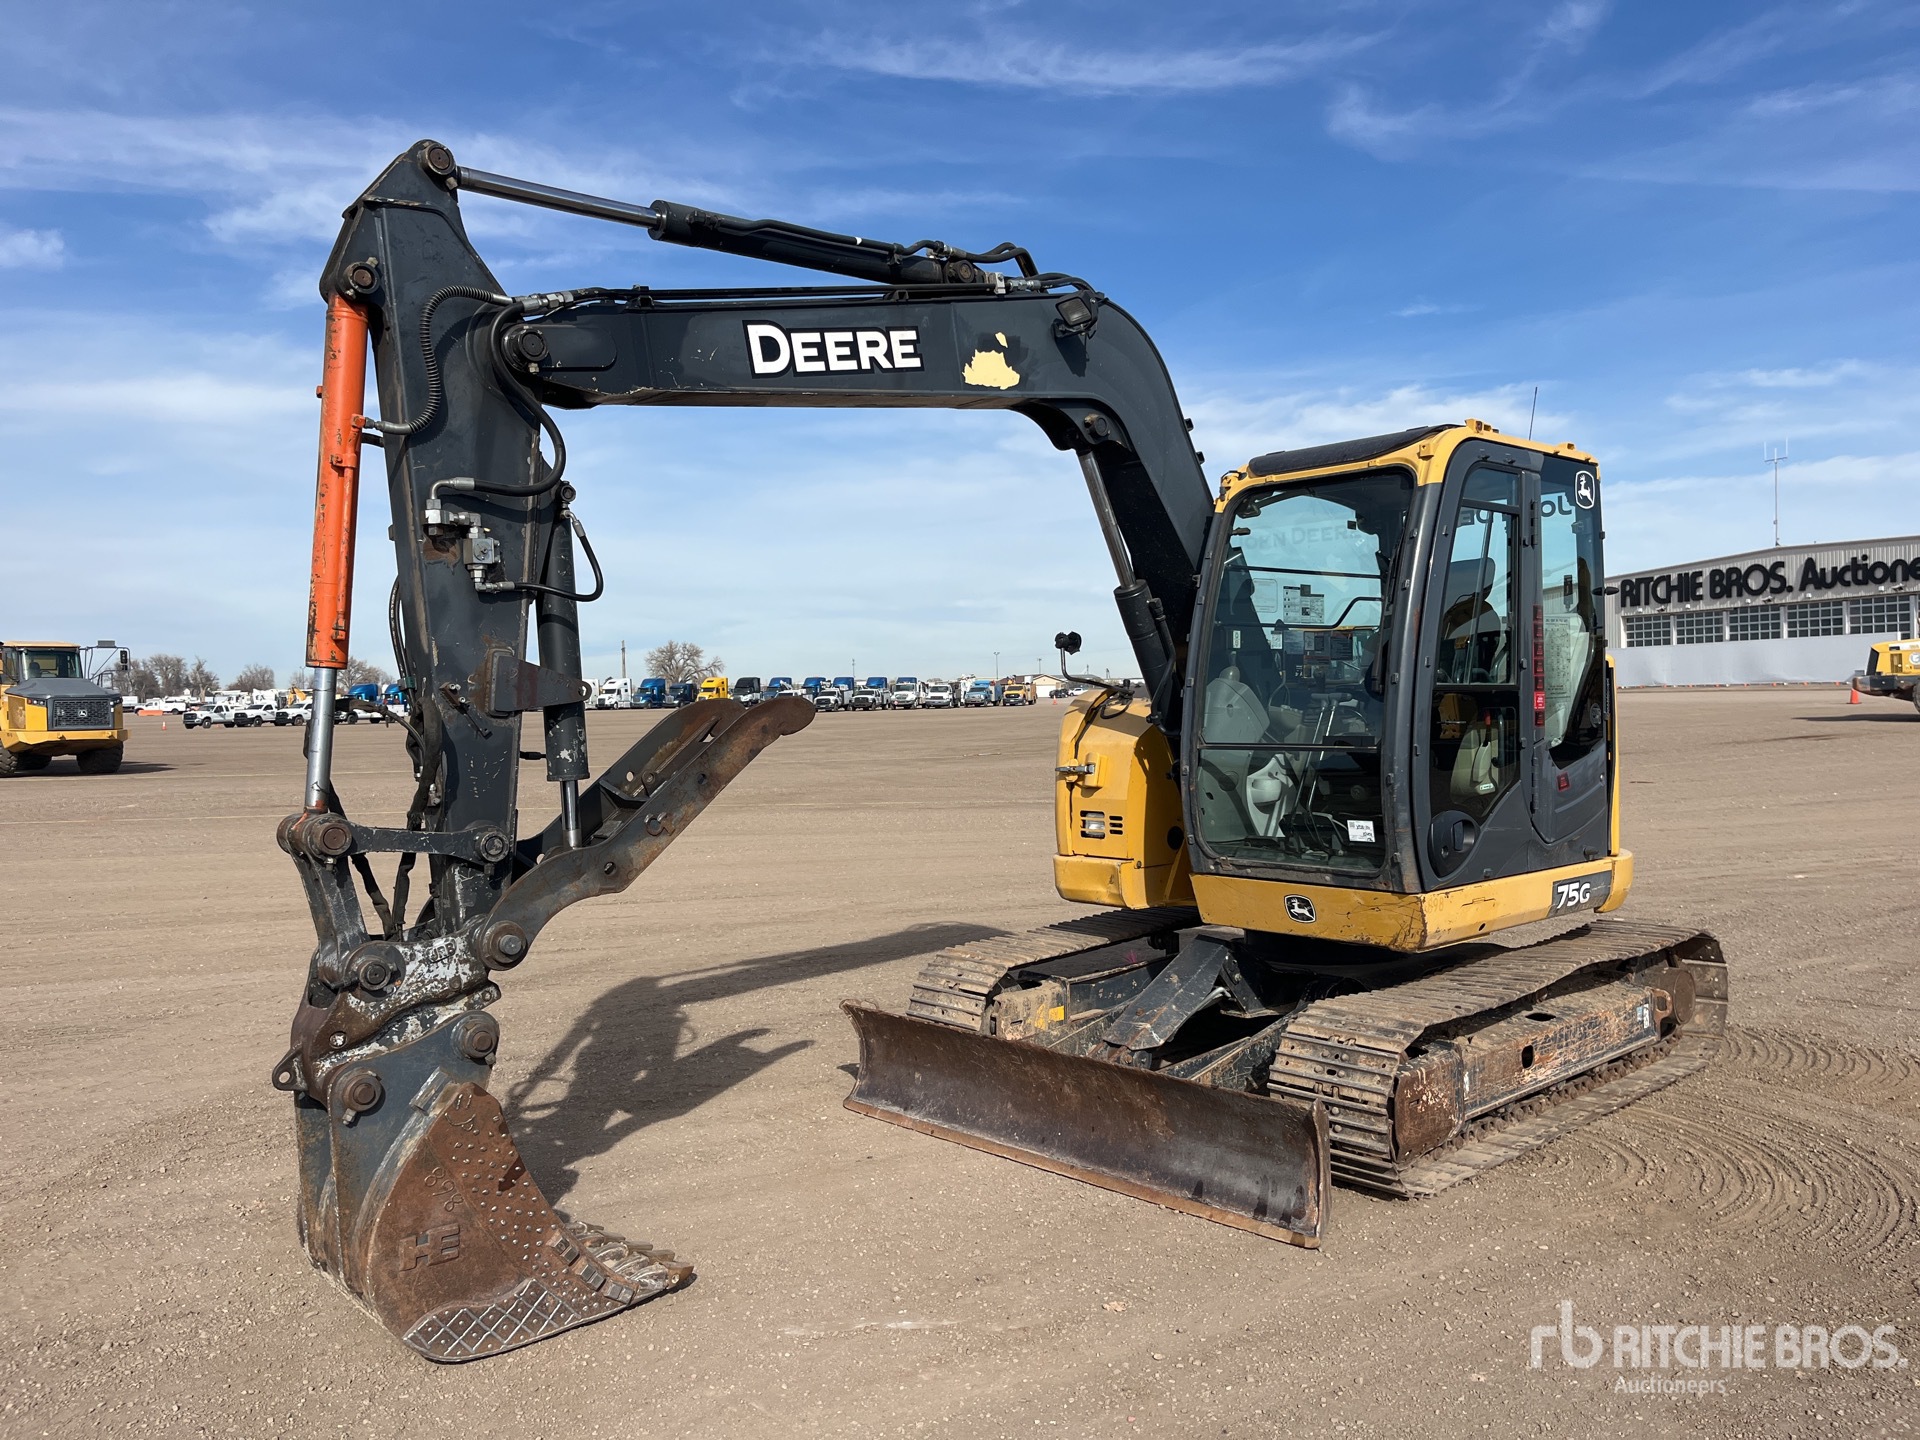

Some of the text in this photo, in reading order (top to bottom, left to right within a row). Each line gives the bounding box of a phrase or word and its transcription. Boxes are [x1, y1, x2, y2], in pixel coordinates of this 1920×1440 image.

[746, 324, 921, 374] DEERE
[1620, 571, 1703, 607] RITCHIE
[1709, 561, 1794, 599] BROS.
[1557, 882, 1591, 909] 75G
